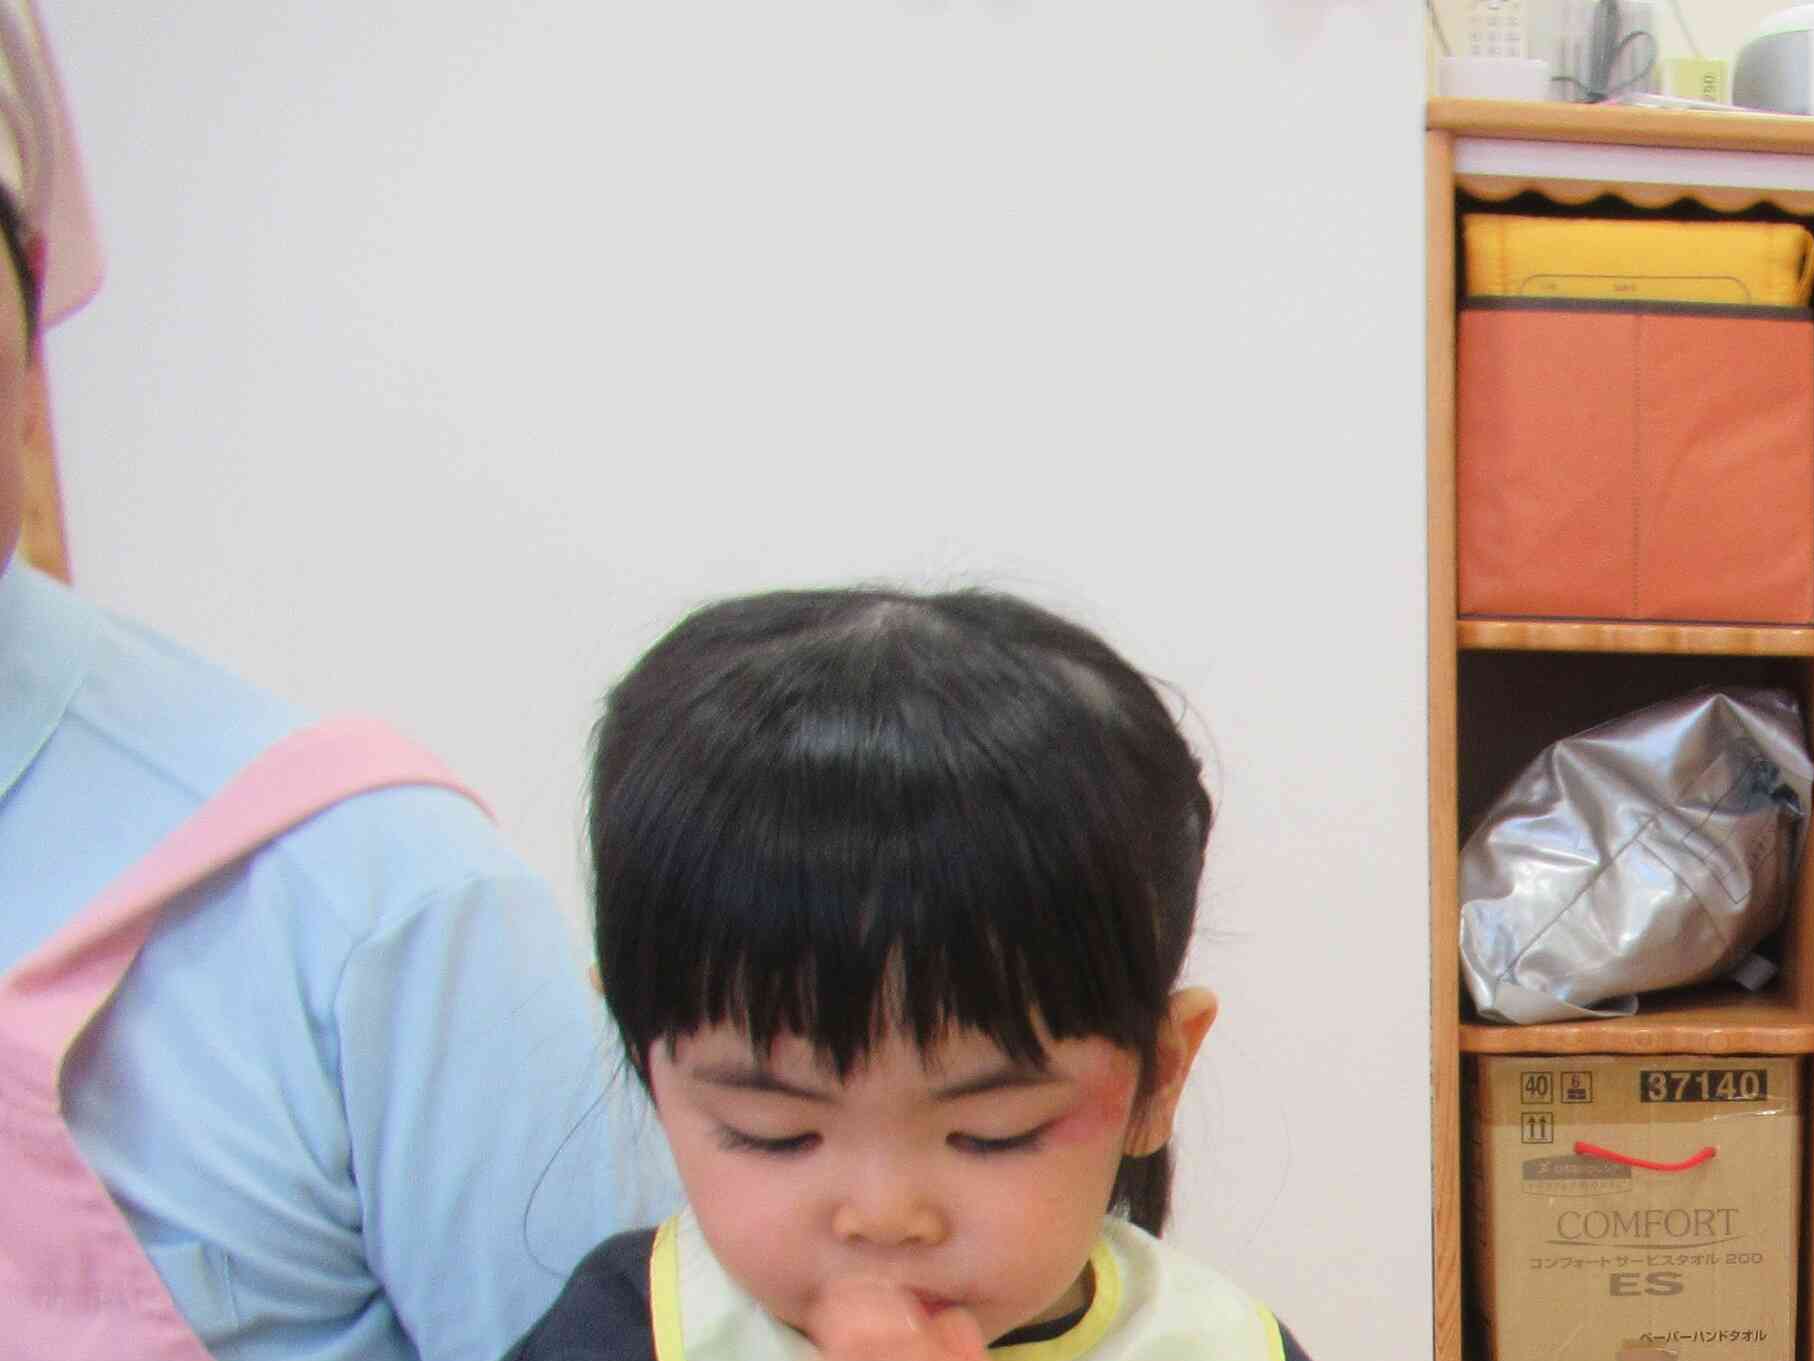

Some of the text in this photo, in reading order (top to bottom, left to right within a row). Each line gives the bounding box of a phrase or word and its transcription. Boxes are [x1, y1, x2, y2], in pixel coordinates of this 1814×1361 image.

[1525, 1075, 1549, 1096] 40
[1647, 1071, 1762, 1102] 37140
[1556, 1207, 1740, 1240] COMFORT
[1725, 1252, 1764, 1266] 200
[1608, 1271, 1684, 1297] ES
[1639, 1329, 1768, 1344] ペーパーハンドタオル
